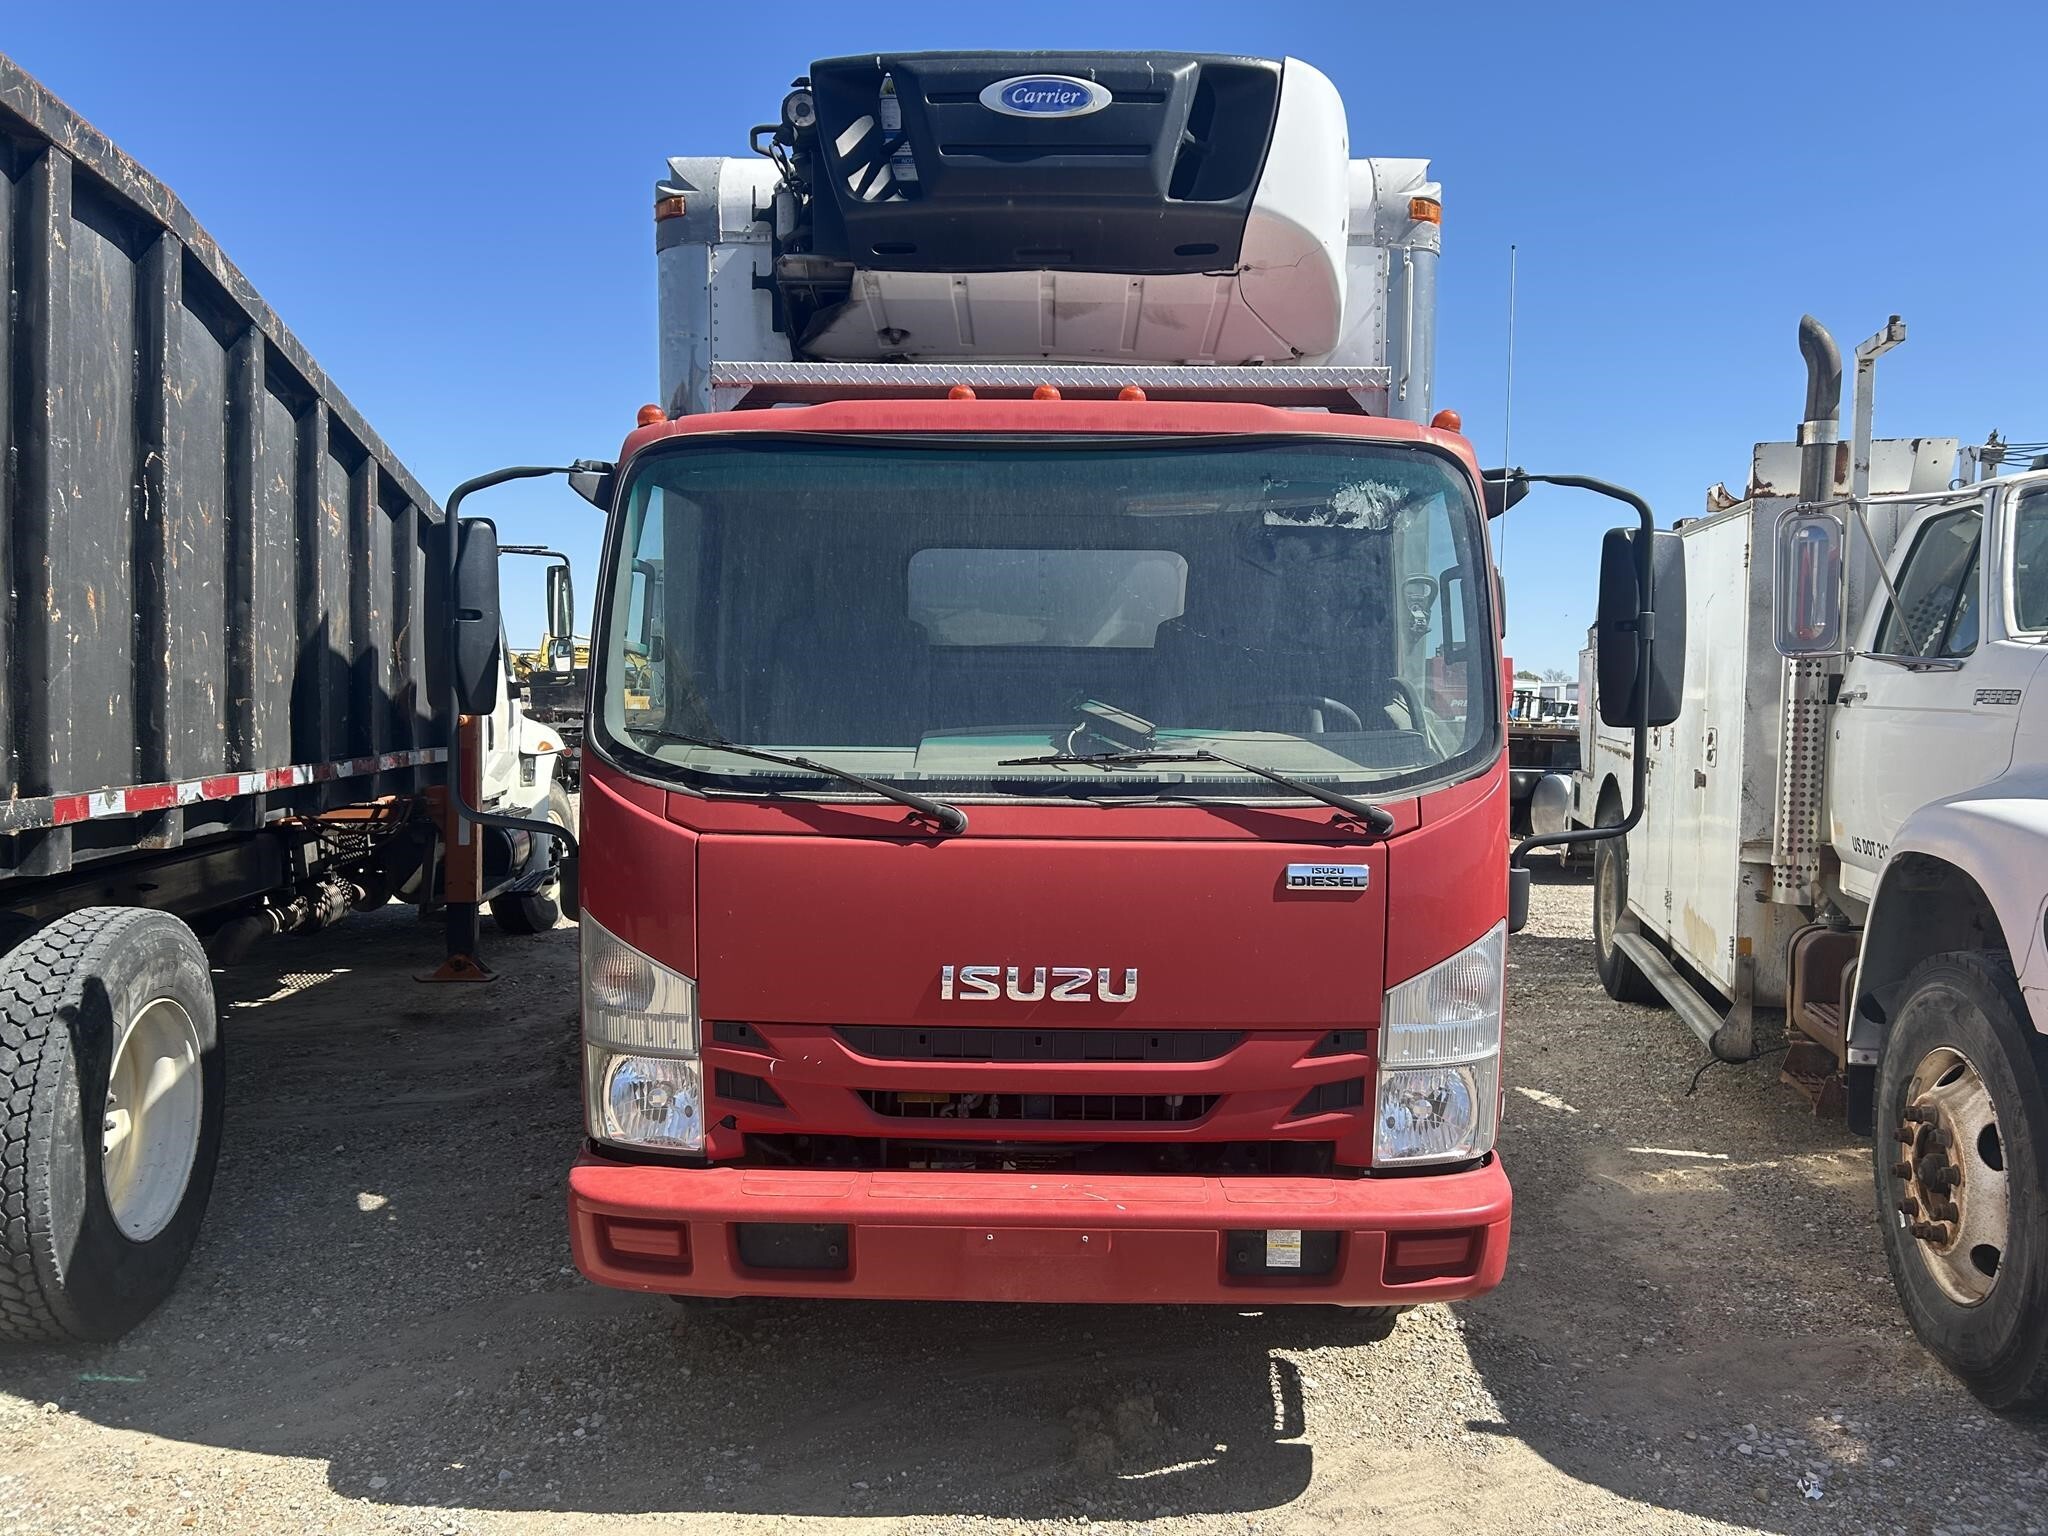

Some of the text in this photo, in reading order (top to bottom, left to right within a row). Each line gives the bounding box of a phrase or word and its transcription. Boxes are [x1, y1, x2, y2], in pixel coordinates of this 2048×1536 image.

[1012, 87, 1080, 104] Carrier
[1851, 836, 1862, 854] US
[1862, 838, 1876, 858] DOT
[1311, 867, 1345, 875] ISUZU
[1291, 876, 1367, 887] DIESEL
[941, 965, 1138, 1003] ISUZU
